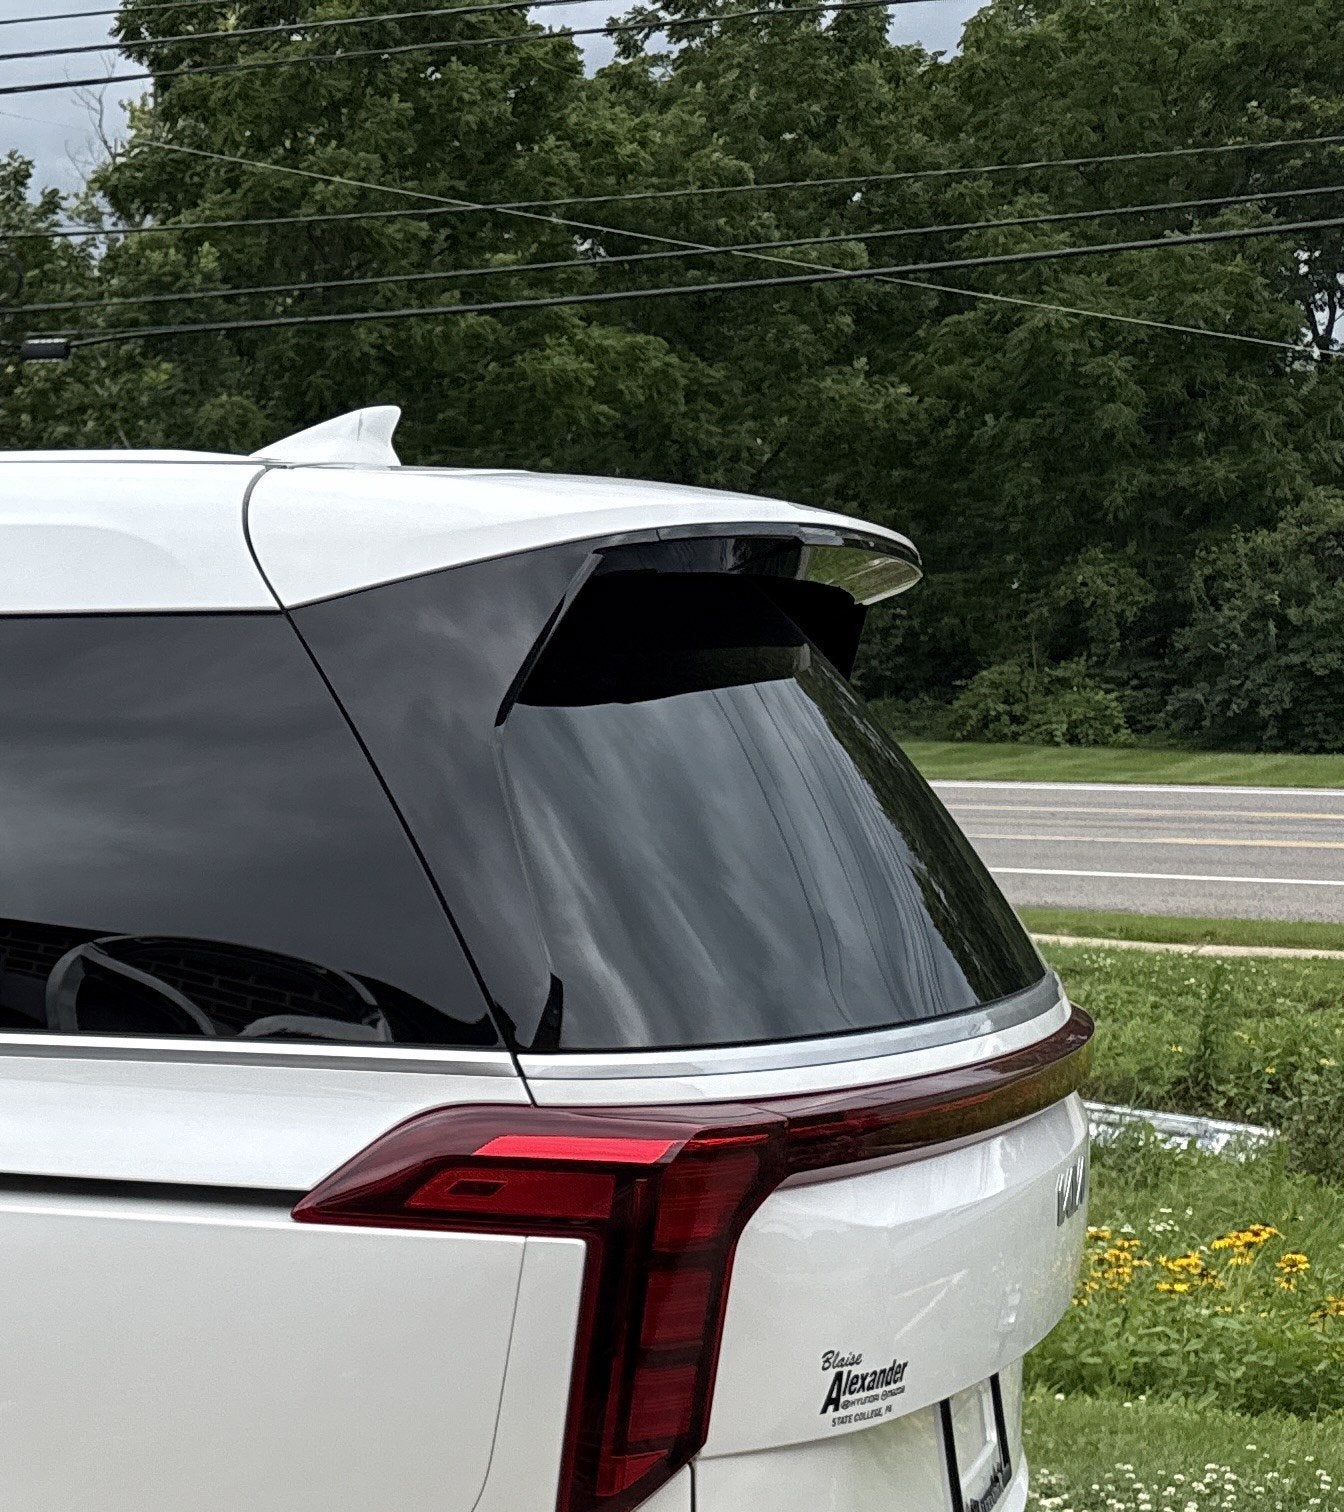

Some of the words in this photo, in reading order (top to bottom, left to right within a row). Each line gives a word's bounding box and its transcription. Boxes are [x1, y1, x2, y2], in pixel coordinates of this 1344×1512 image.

[821, 1349, 863, 1372] Blaise
[819, 1358, 909, 1415] Alexander
[831, 1413, 854, 1427] STATE
